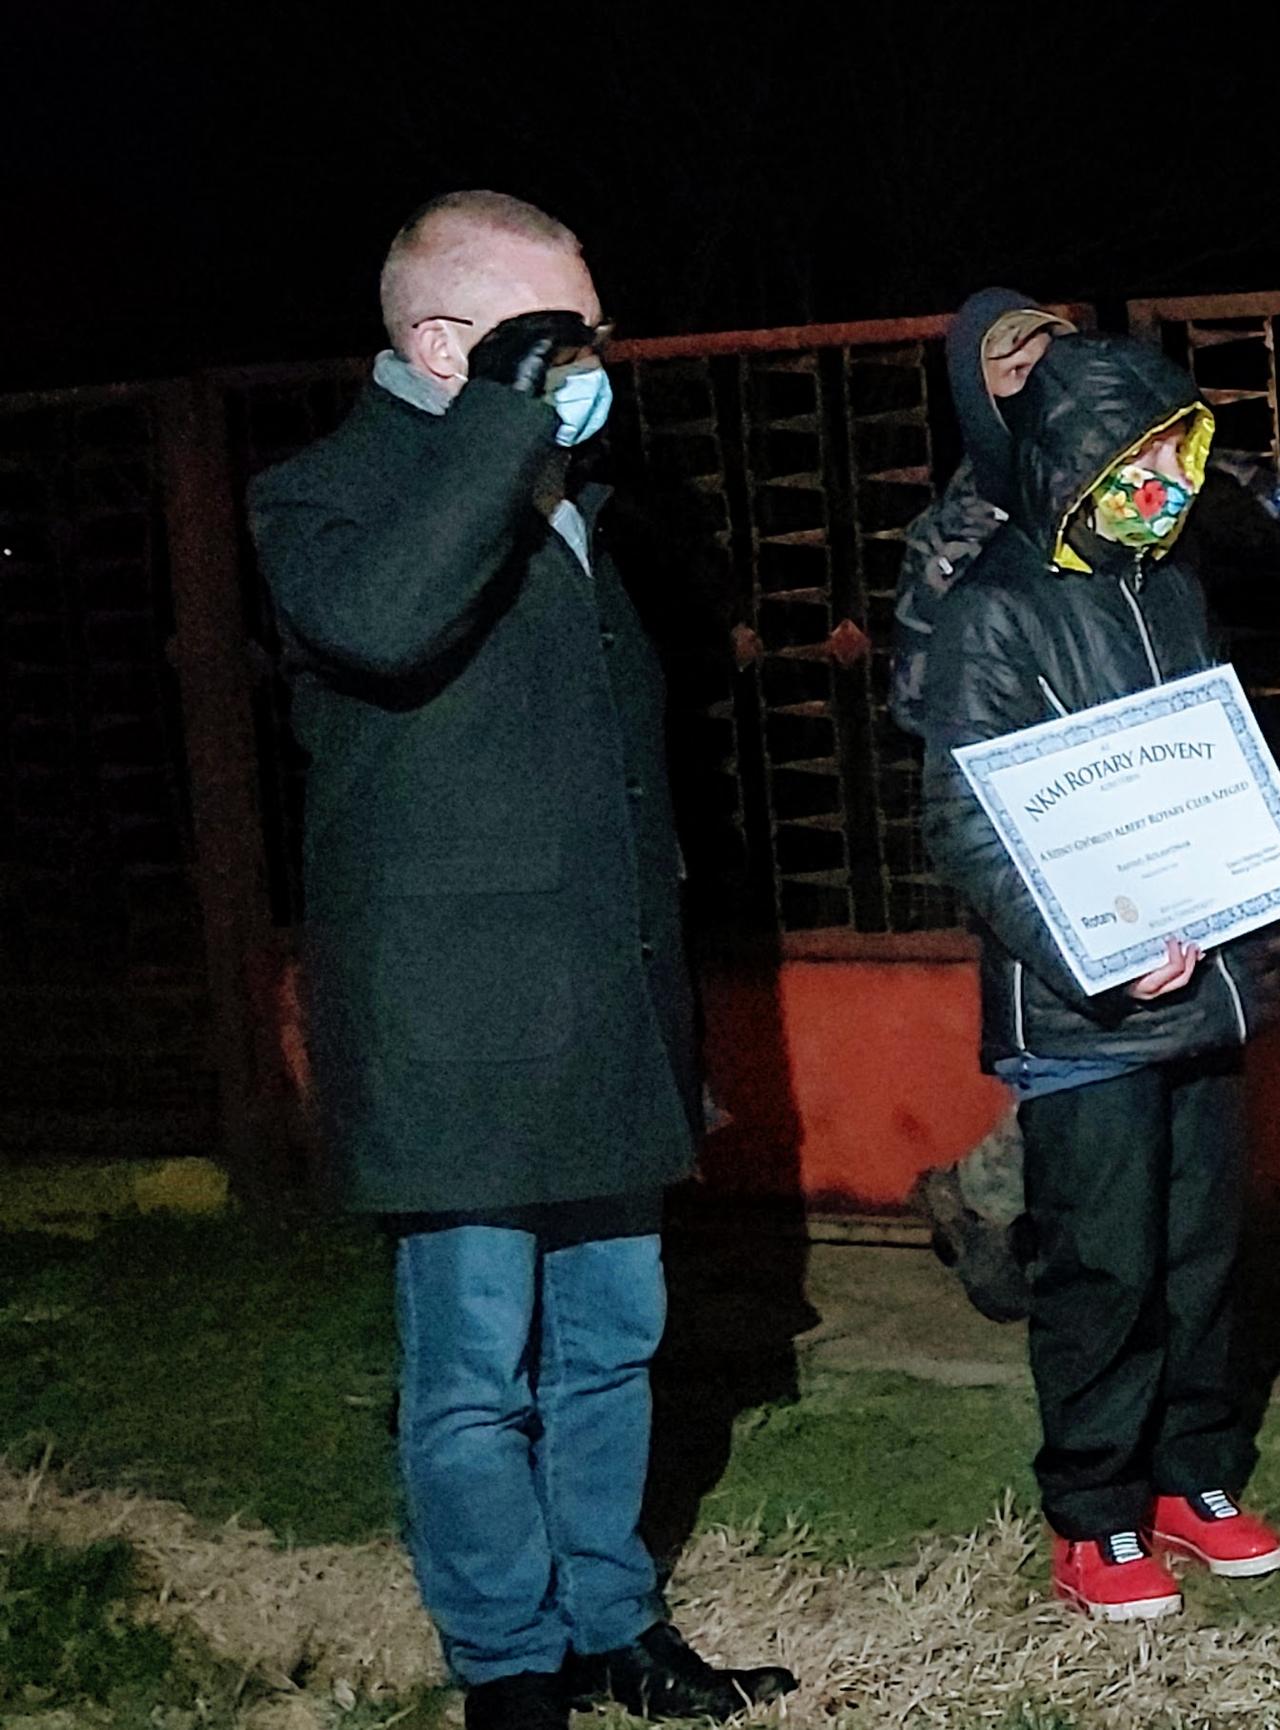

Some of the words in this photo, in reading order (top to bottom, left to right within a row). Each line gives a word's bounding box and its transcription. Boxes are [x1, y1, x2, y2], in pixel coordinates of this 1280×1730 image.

[1024, 779, 1069, 823] NKM
[1064, 750, 1134, 791] ROTARY
[1139, 742, 1217, 766] ADVENT
[1081, 910, 1118, 931] Rotary
